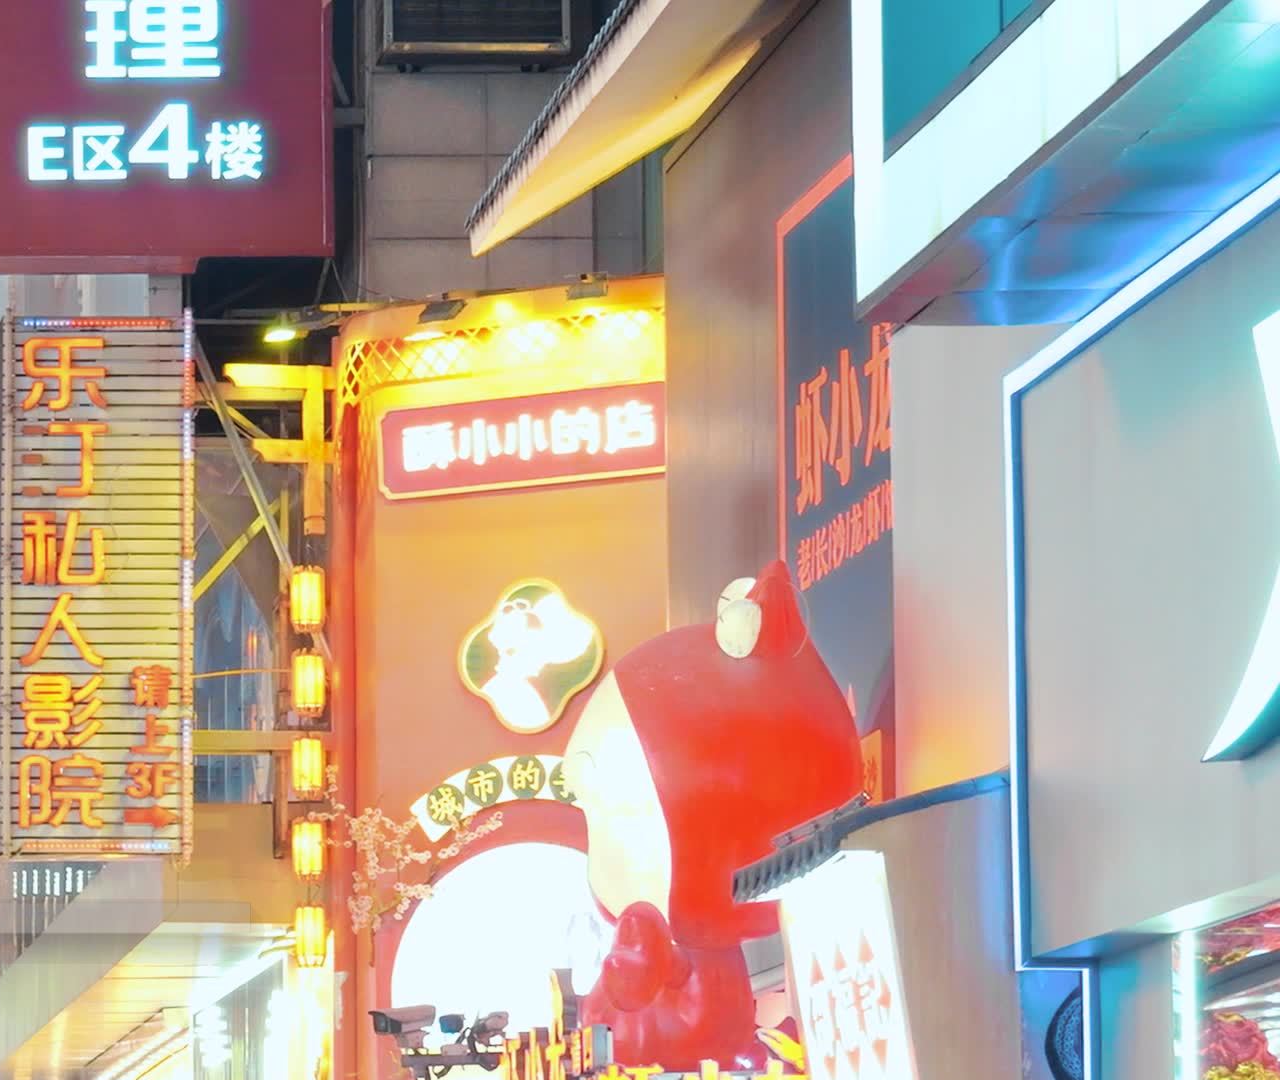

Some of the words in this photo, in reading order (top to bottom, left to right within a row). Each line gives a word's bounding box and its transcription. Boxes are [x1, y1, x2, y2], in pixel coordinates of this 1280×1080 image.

[84, 0, 222, 78] 理
[26, 103, 265, 181] E区4楼
[18, 336, 108, 829] 乐汀私人影院
[123, 664, 178, 800] 请上3F
